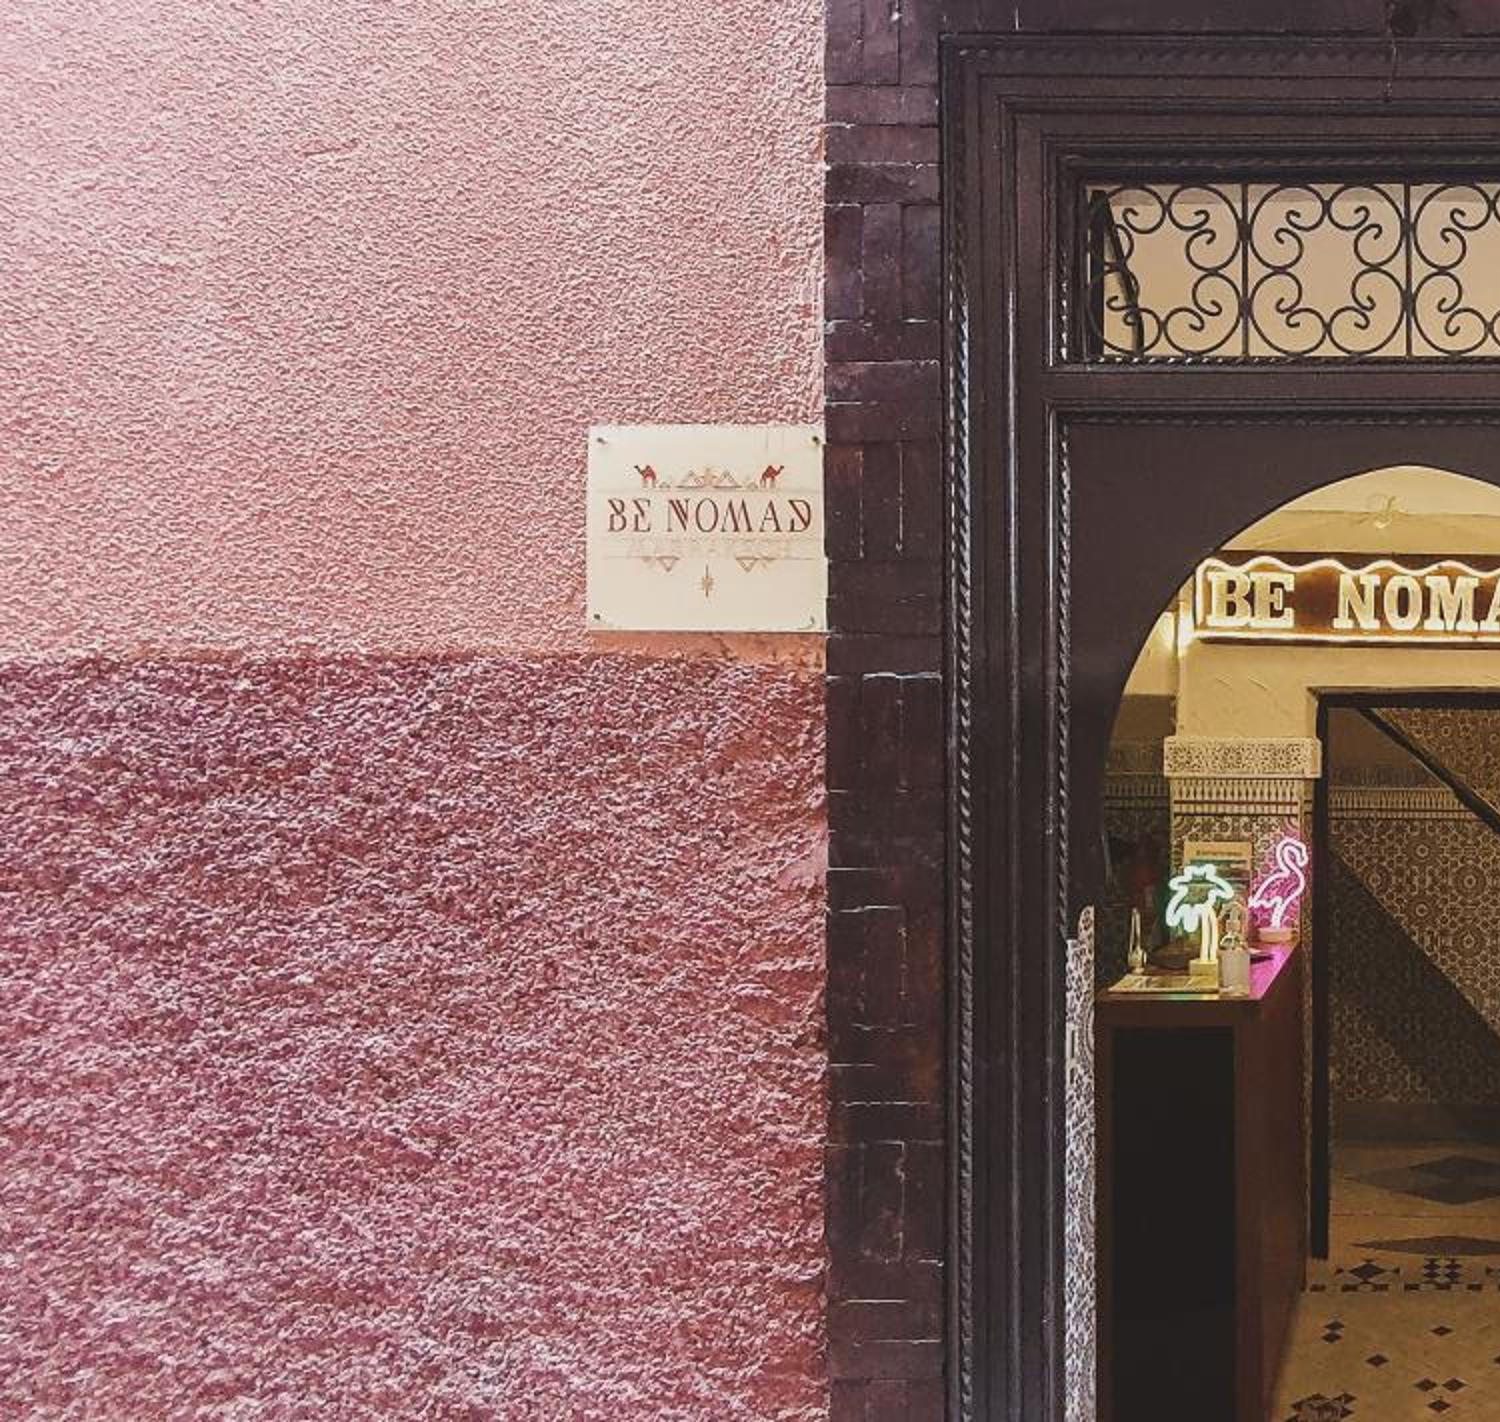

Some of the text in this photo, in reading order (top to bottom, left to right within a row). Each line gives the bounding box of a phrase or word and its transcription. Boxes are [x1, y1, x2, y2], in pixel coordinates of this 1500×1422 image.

[608, 498, 813, 533] BE NOMAD
[1207, 571, 1295, 628] BE
